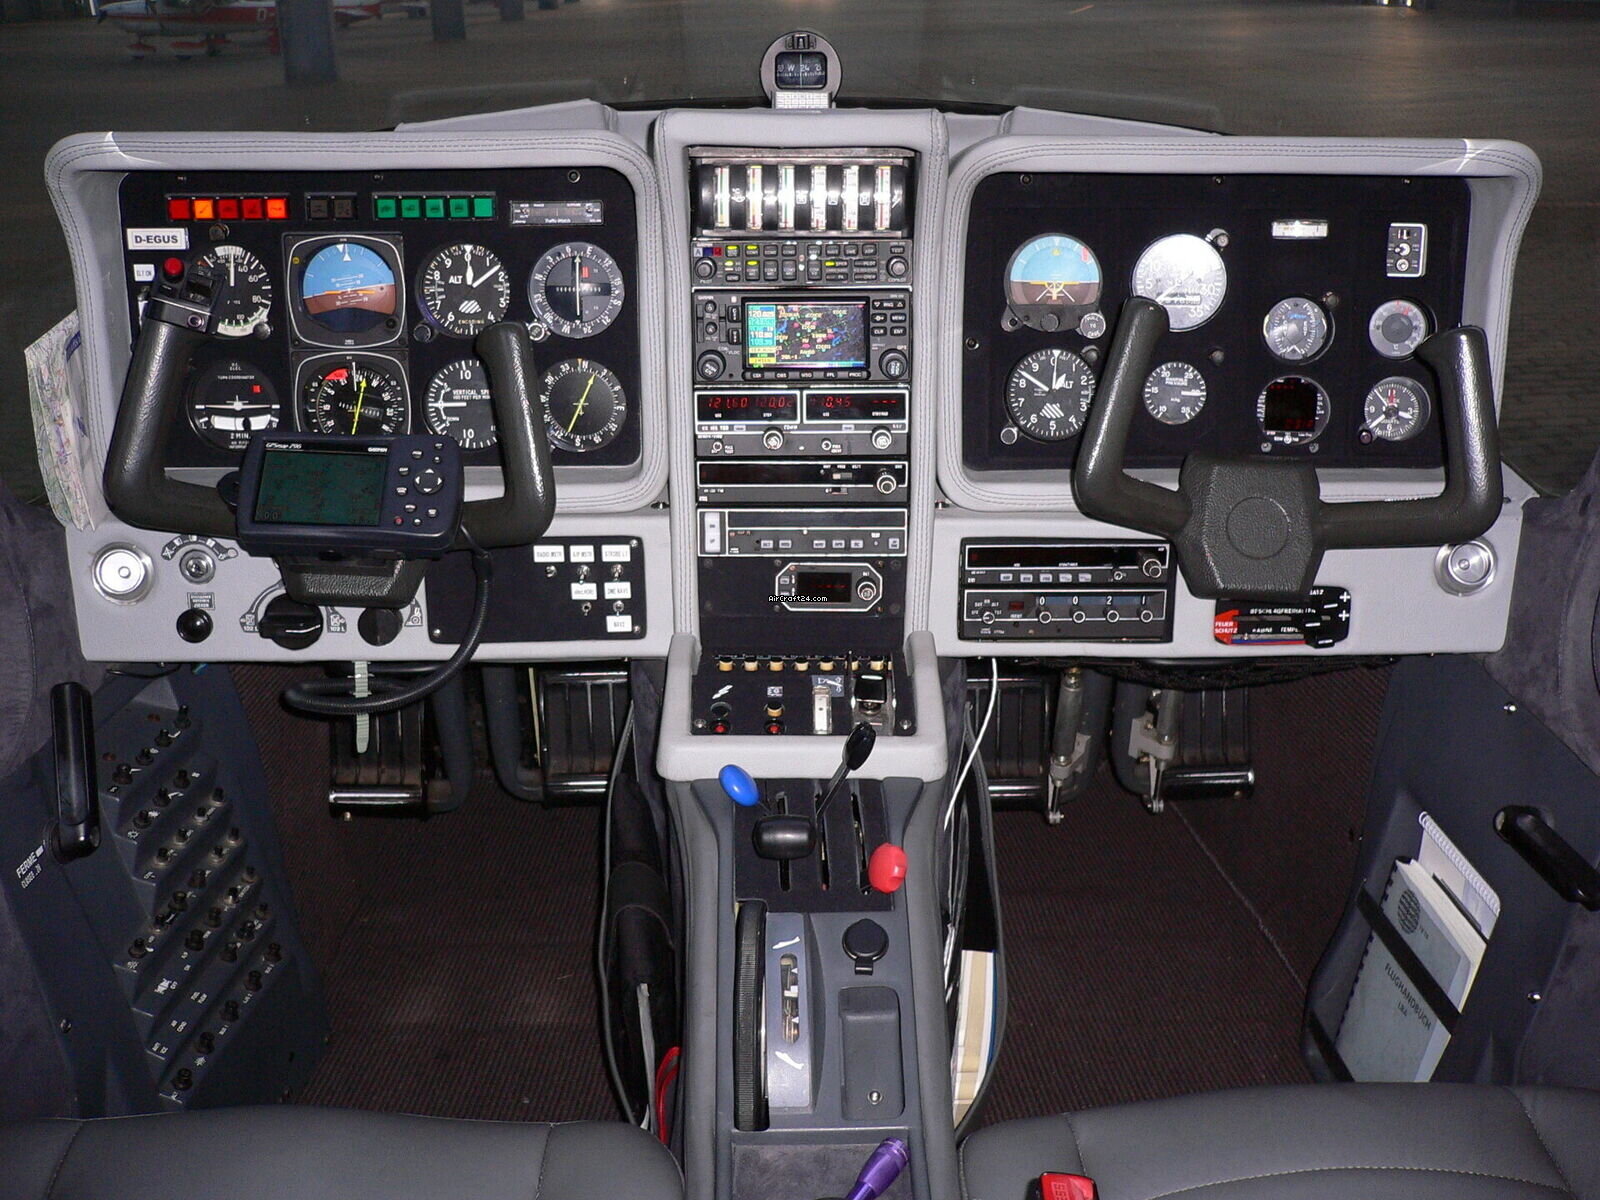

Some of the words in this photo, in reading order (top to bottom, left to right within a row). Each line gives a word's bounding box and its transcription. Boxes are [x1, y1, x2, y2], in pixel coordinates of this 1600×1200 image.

[134, 235, 178, 244] D-EGUS
[586, 246, 593, 255] E
[444, 258, 452, 269] 9
[433, 270, 440, 281] 8
[448, 275, 463, 284] ALT
[498, 271, 505, 282] 2
[1200, 283, 1215, 296] 30
[252, 295, 261, 303] 80
[435, 300, 441, 310] 7
[447, 311, 455, 321] 6
[487, 311, 495, 321] 4
[1188, 308, 1204, 318] 35
[560, 363, 570, 373] 33
[582, 360, 589, 369] N
[1031, 363, 1039, 372] 9
[460, 370, 471, 380] 10
[1161, 370, 1171, 378] 20
[1019, 379, 1026, 388] 8
[1080, 375, 1087, 385] 2
[1151, 386, 1159, 394] 15
[1018, 397, 1025, 407] 7
[1080, 402, 1087, 411] 3
[1159, 405, 1167, 413] 10
[1369, 405, 1376, 413] 9
[1407, 407, 1413, 415] 3
[1030, 414, 1038, 423] 6
[1068, 415, 1076, 423] 4
[1049, 420, 1056, 430] 5
[1386, 423, 1393, 431] 6
[463, 428, 475, 439] 10
[1384, 962, 1432, 1031] FLUGHANDBUCH
